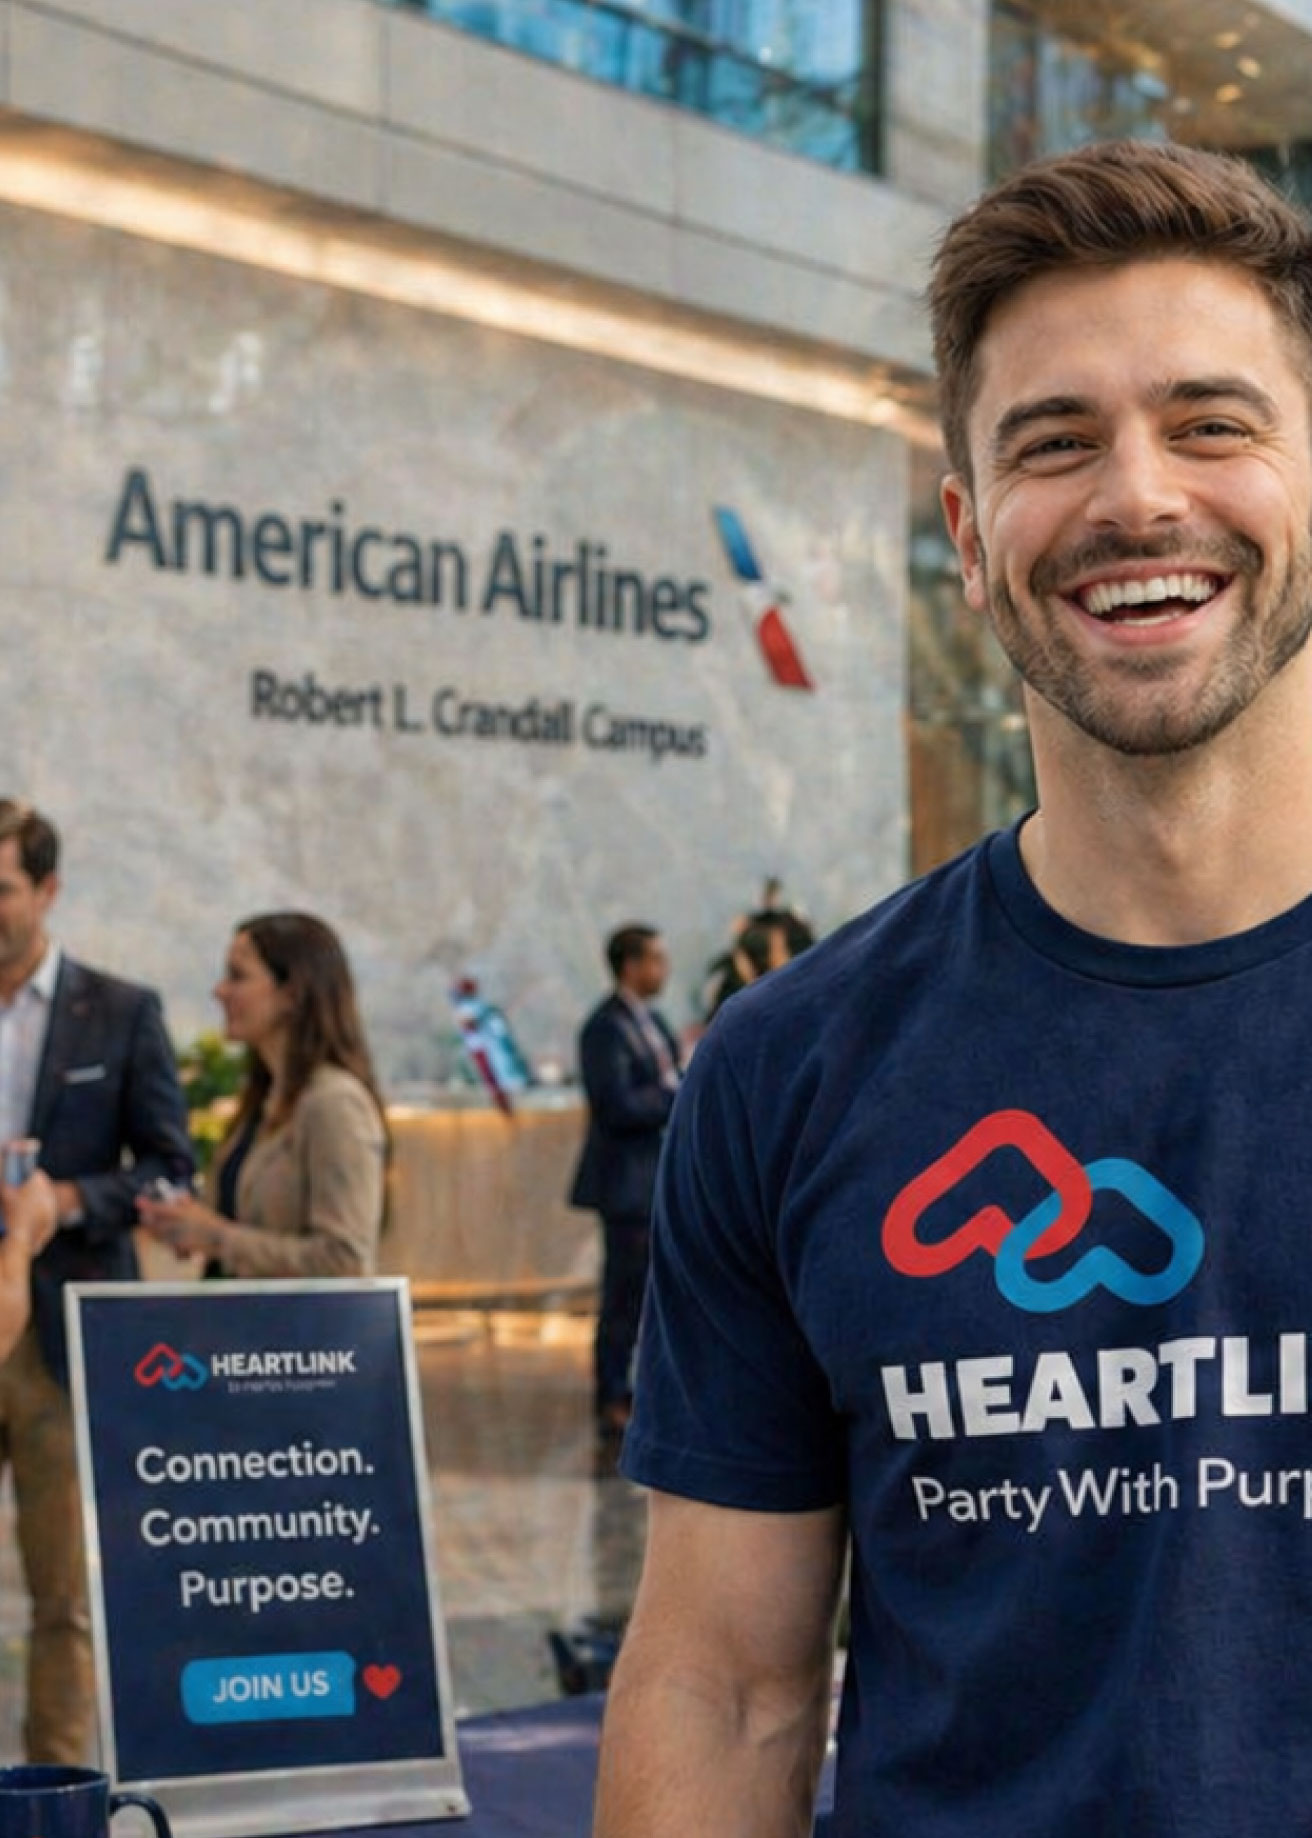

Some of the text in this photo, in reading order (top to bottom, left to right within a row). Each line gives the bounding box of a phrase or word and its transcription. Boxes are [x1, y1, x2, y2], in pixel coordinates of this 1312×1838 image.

[105, 468, 711, 644] American Airlines
[250, 669, 706, 763] Robert L. Crandall Campus
[211, 1350, 358, 1377] HEARTLINK
[136, 1441, 375, 1484] Connection.
[911, 1476, 1052, 1533] Party
[1058, 1463, 1179, 1517] With
[141, 1501, 381, 1547] Community.
[180, 1571, 356, 1613] Purpose.
[213, 1670, 330, 1704] JOIN US
